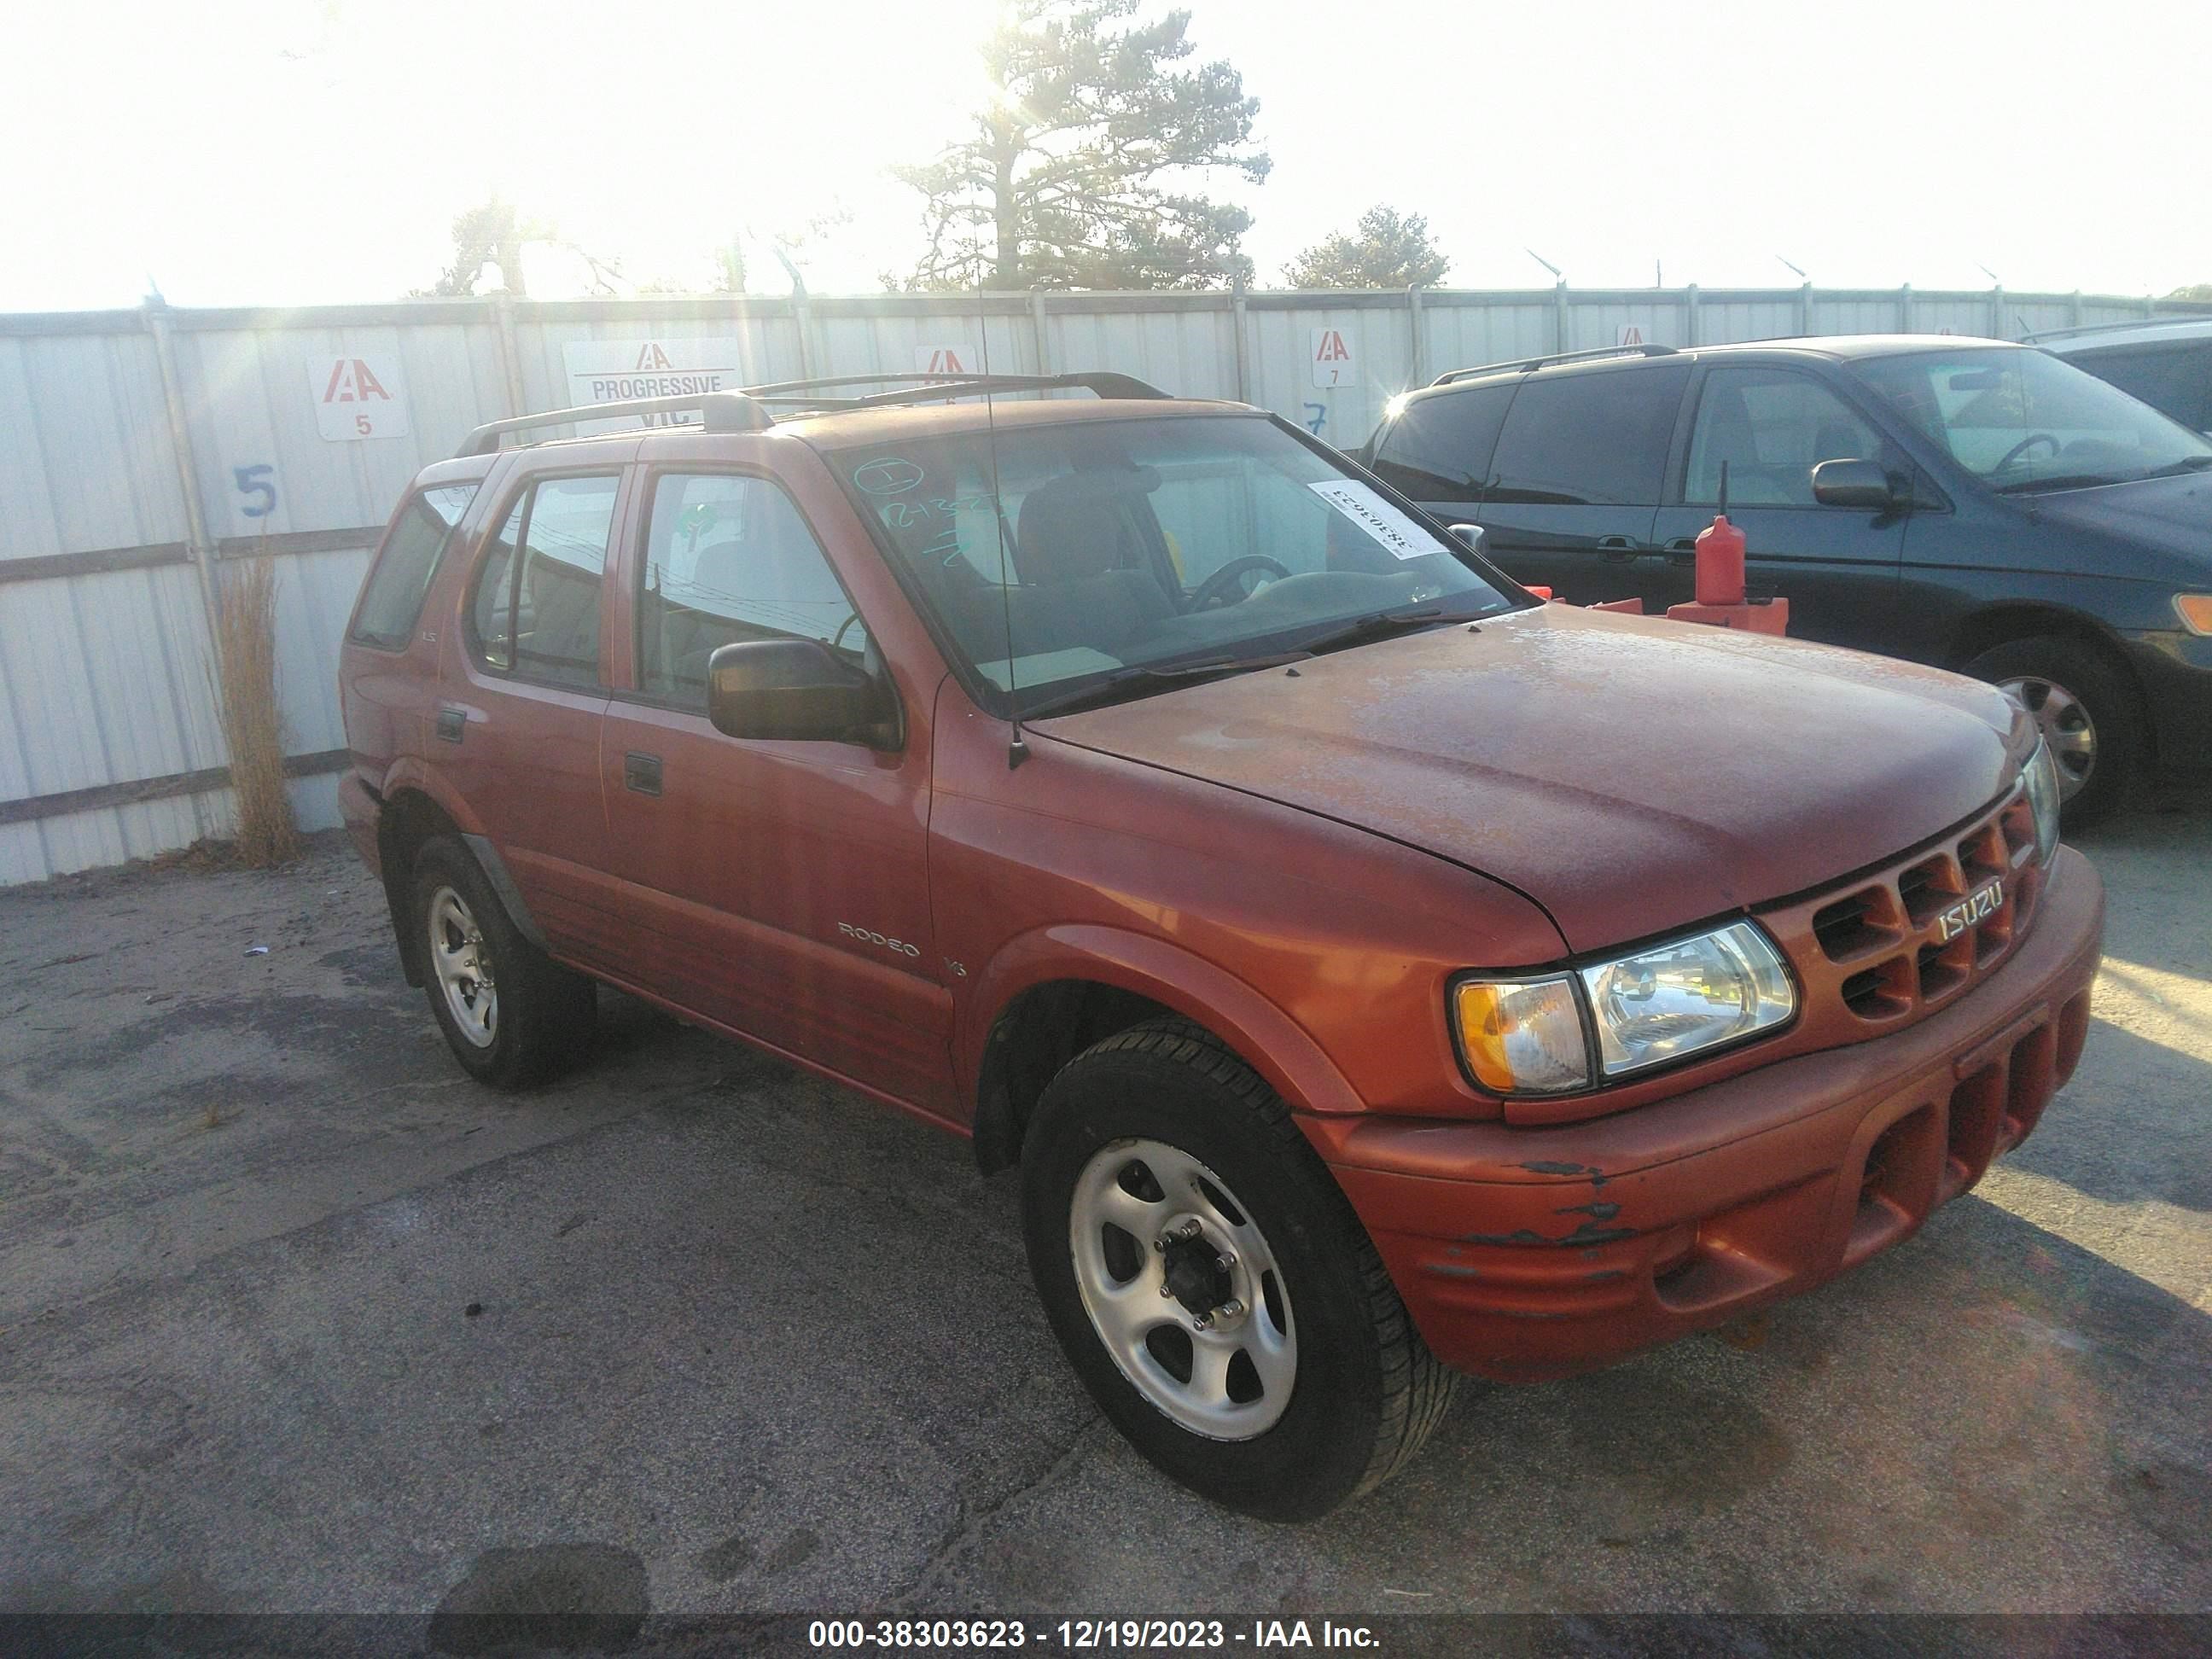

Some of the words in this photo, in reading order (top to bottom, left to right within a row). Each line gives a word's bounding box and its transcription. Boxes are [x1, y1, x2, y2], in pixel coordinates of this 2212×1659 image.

[591, 375, 722, 399] PROGRESSIVE
[1331, 370, 1339, 384] 7
[355, 415, 372, 435] 5
[1303, 402, 1326, 436] 7
[234, 464, 276, 517] 5
[1939, 881, 2003, 940] ISUZU
[837, 921, 921, 957] RODEO
